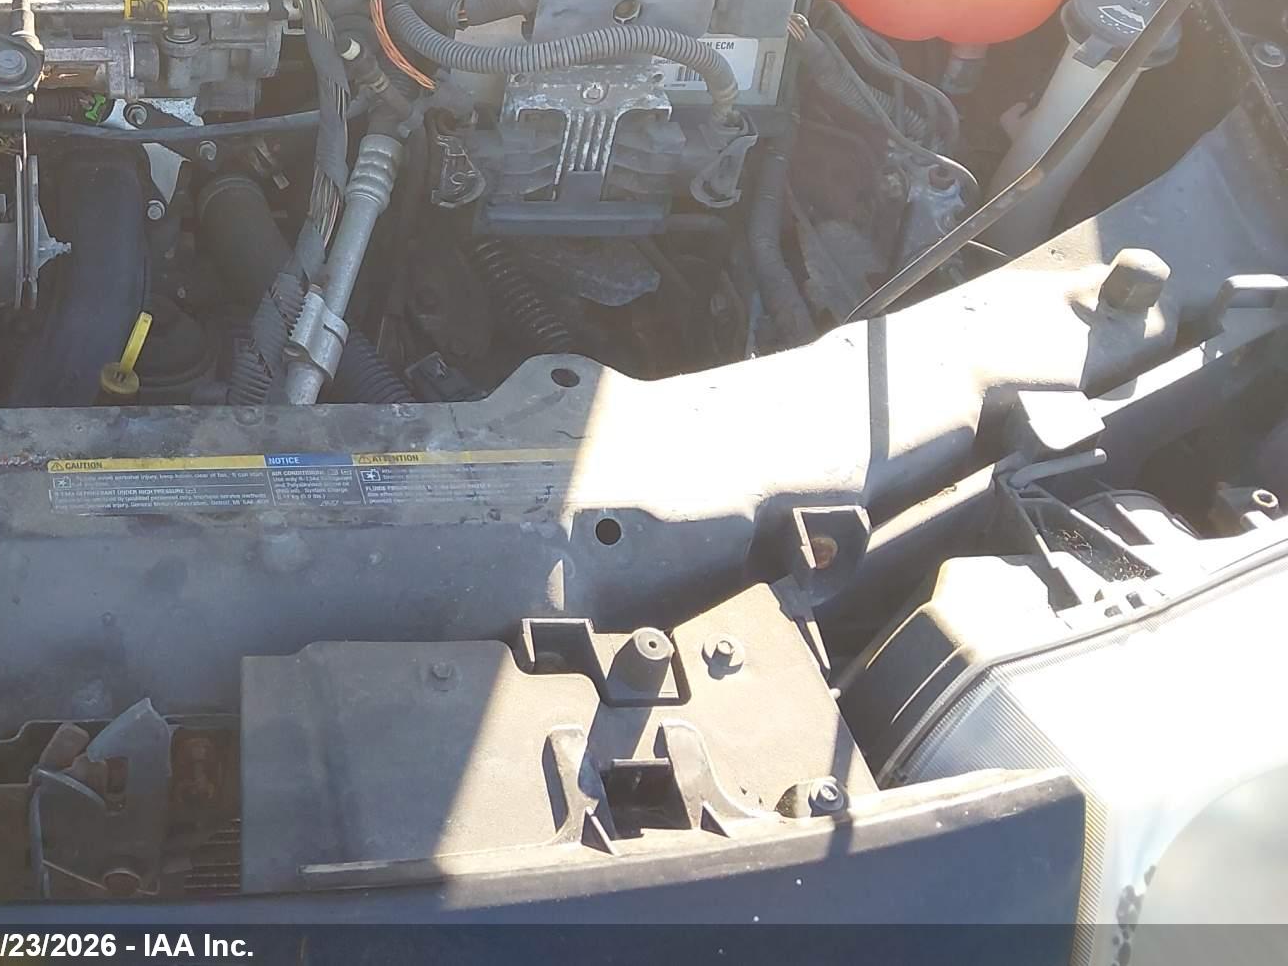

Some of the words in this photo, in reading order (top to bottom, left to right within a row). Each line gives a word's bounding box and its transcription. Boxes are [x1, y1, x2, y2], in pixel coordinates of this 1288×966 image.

[715, 41, 735, 50] ECM
[268, 456, 301, 465] NOTICE
[65, 461, 103, 470] CAUTION
